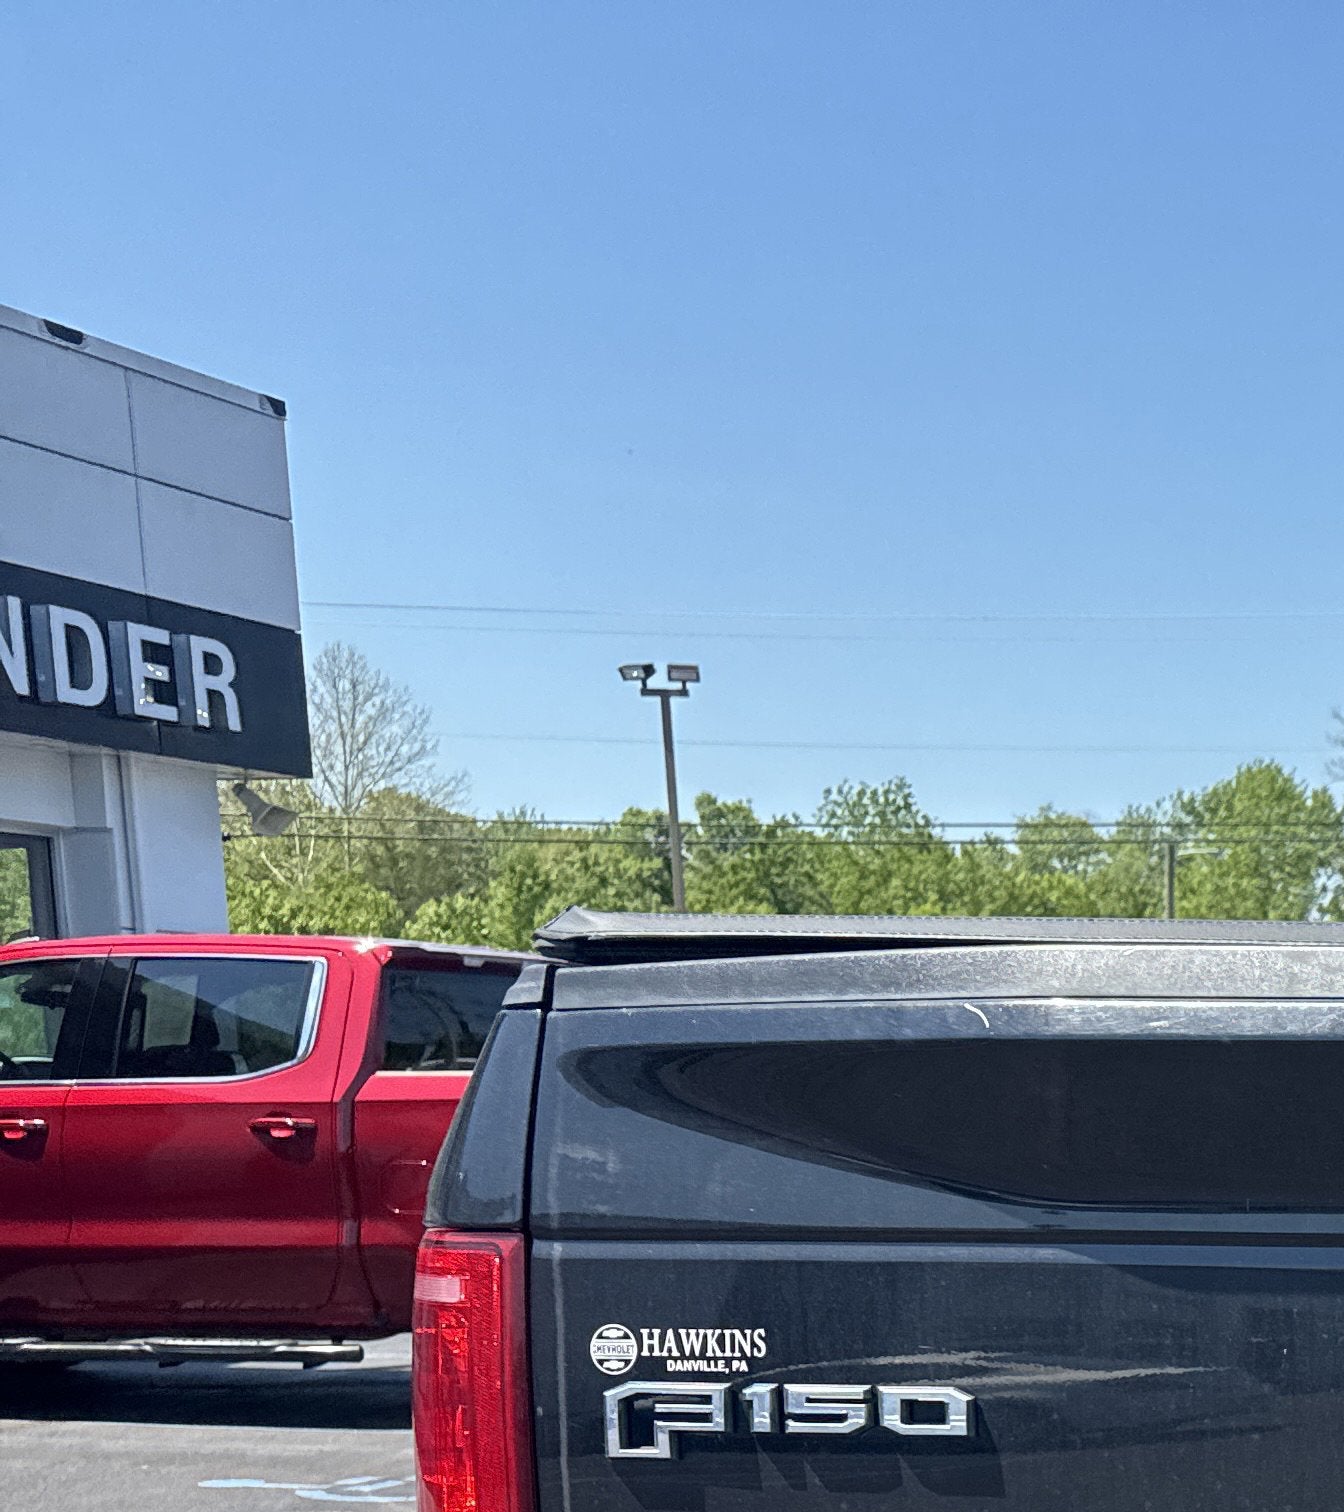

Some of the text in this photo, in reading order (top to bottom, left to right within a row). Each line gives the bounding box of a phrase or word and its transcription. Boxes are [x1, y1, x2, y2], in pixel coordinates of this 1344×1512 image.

[640, 1327, 767, 1358] HAWKINS
[666, 1359, 749, 1374] DANVILLE, PA
